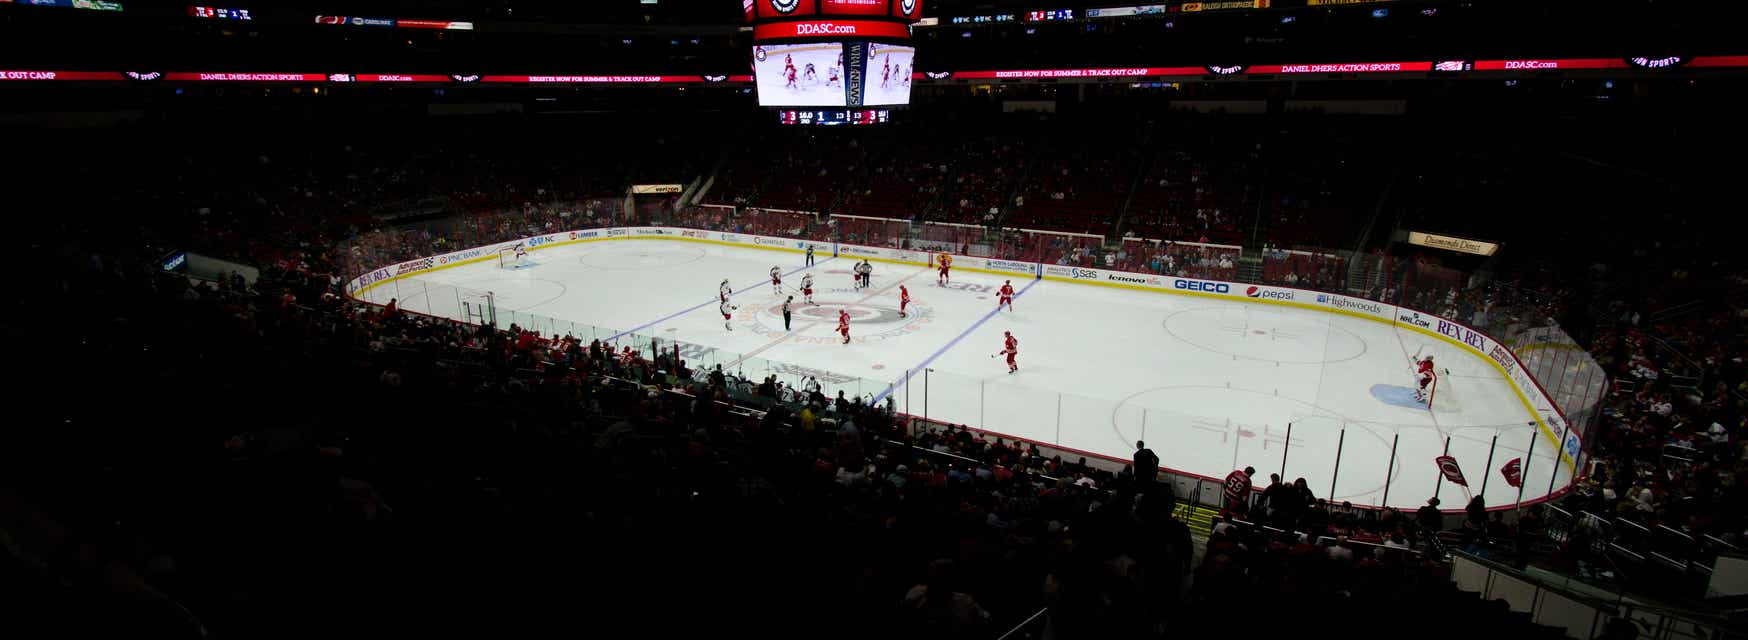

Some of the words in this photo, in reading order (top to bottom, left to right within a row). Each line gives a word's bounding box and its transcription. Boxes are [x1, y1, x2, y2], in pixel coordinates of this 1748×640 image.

[796, 23, 856, 35] DDASC.com
[850, 44, 861, 70] WRAL
[1648, 56, 1680, 69] SPORTS
[1221, 65, 1242, 75] SPORTS
[1281, 65, 1310, 73] DANIEL
[1311, 65, 1337, 73] DHERS
[1337, 64, 1369, 72] ACTION
[1369, 63, 1400, 71] SPORTS
[1504, 61, 1557, 70] DDASC.com
[8, 71, 28, 80] OUT
[29, 71, 56, 80] CAMP
[200, 73, 226, 81] DANIEL
[252, 73, 278, 81] ACTION
[279, 73, 304, 81] SPORTS
[850, 71, 861, 106] NEWS
[790, 111, 796, 121] 3
[817, 111, 825, 121] 1
[870, 110, 876, 120] 3
[544, 235, 554, 243] NC
[577, 231, 598, 239] LUMBER
[1424, 235, 1458, 248] Diamonds
[1459, 240, 1481, 253] Direct
[447, 254, 462, 263] PNC
[463, 250, 482, 261] BANK
[359, 273, 373, 288] REX
[374, 268, 392, 283] REX
[1079, 268, 1097, 279] sas
[1108, 274, 1146, 284] lenovo
[1174, 279, 1229, 294] GEICO
[1262, 290, 1294, 301] pepsi
[1326, 295, 1382, 313] Highwoods
[1400, 315, 1430, 328] NHL.COM
[1437, 319, 1462, 341] REX
[1463, 329, 1487, 352] REX
